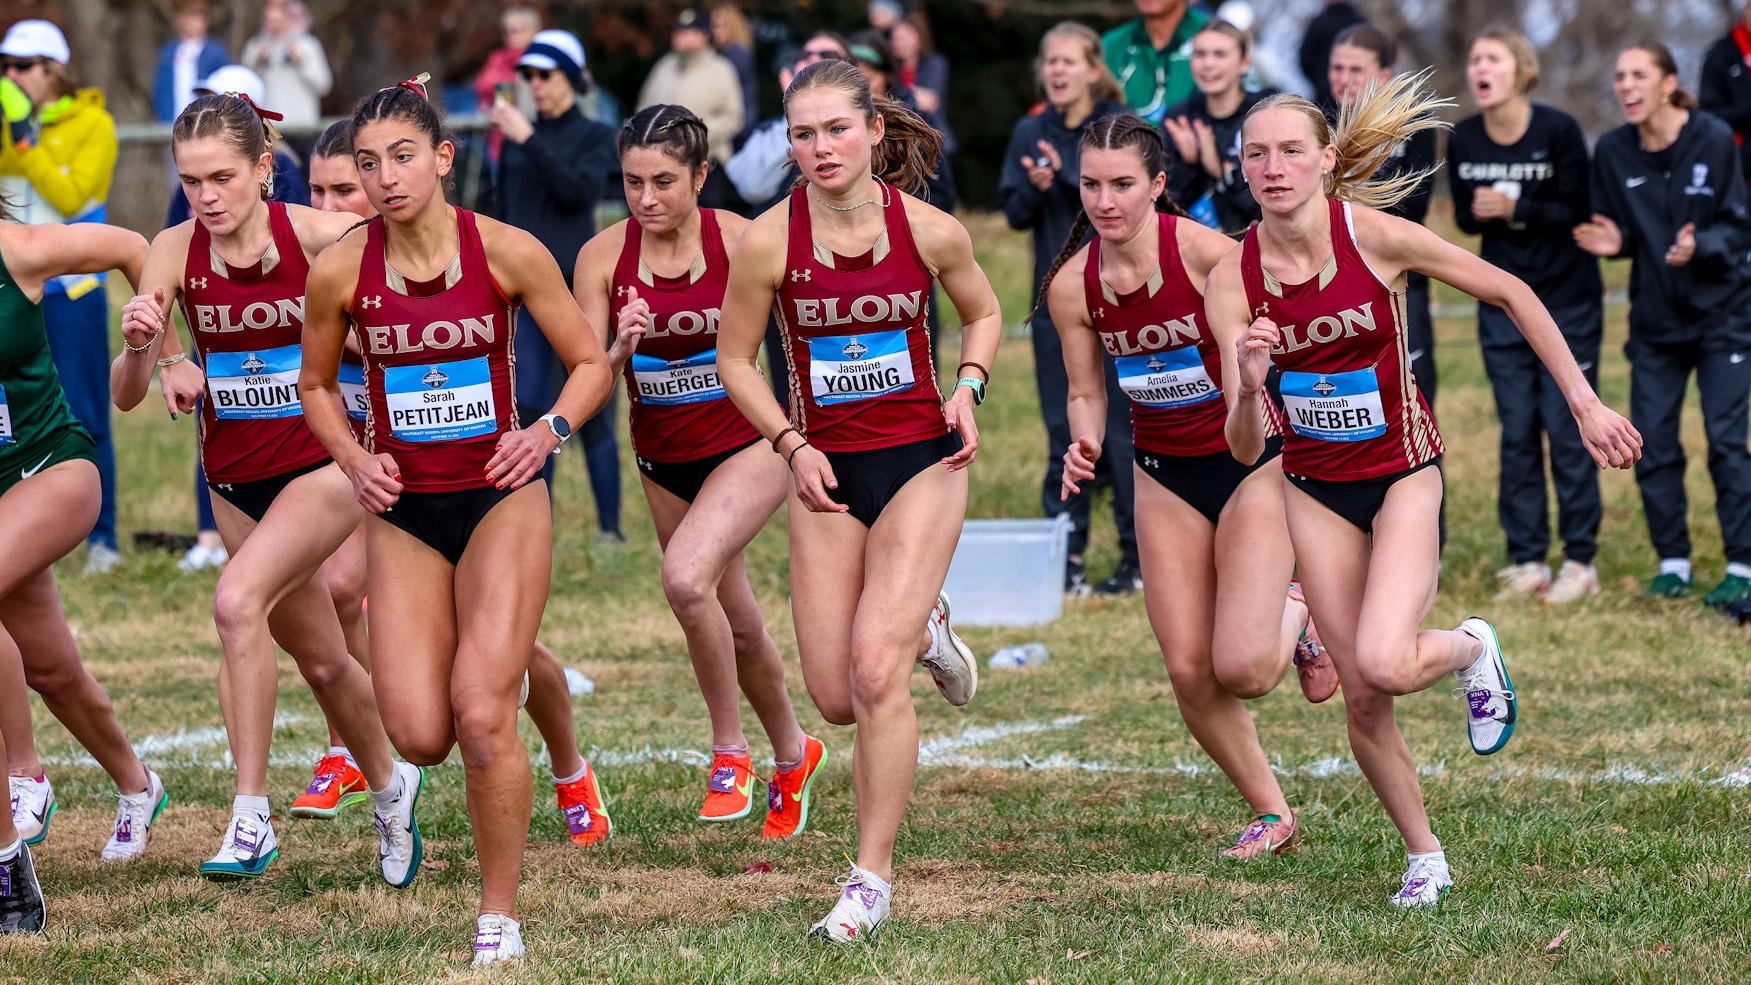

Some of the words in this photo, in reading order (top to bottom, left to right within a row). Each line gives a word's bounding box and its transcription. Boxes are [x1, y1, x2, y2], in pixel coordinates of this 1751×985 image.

[195, 295, 306, 333] ELON
[793, 290, 923, 327] ELON
[365, 313, 495, 355] ELON
[616, 308, 721, 339] LON
[1098, 313, 1201, 356] ELON
[670, 368, 693, 379] Kate
[838, 361, 881, 374] Jasmine
[244, 375, 271, 386] Katie
[822, 367, 900, 393] YOUNG
[1128, 379, 1211, 401] SUMMERS
[1147, 373, 1178, 387] Amelia
[217, 383, 301, 407] BLOUNT
[423, 390, 456, 403] Sarah
[1309, 398, 1349, 409] Hannah
[393, 400, 490, 426] PETITJEAN
[1295, 407, 1373, 429] WEBER
[1470, 690, 1489, 698] LYNX
[566, 803, 585, 815] LYNX
